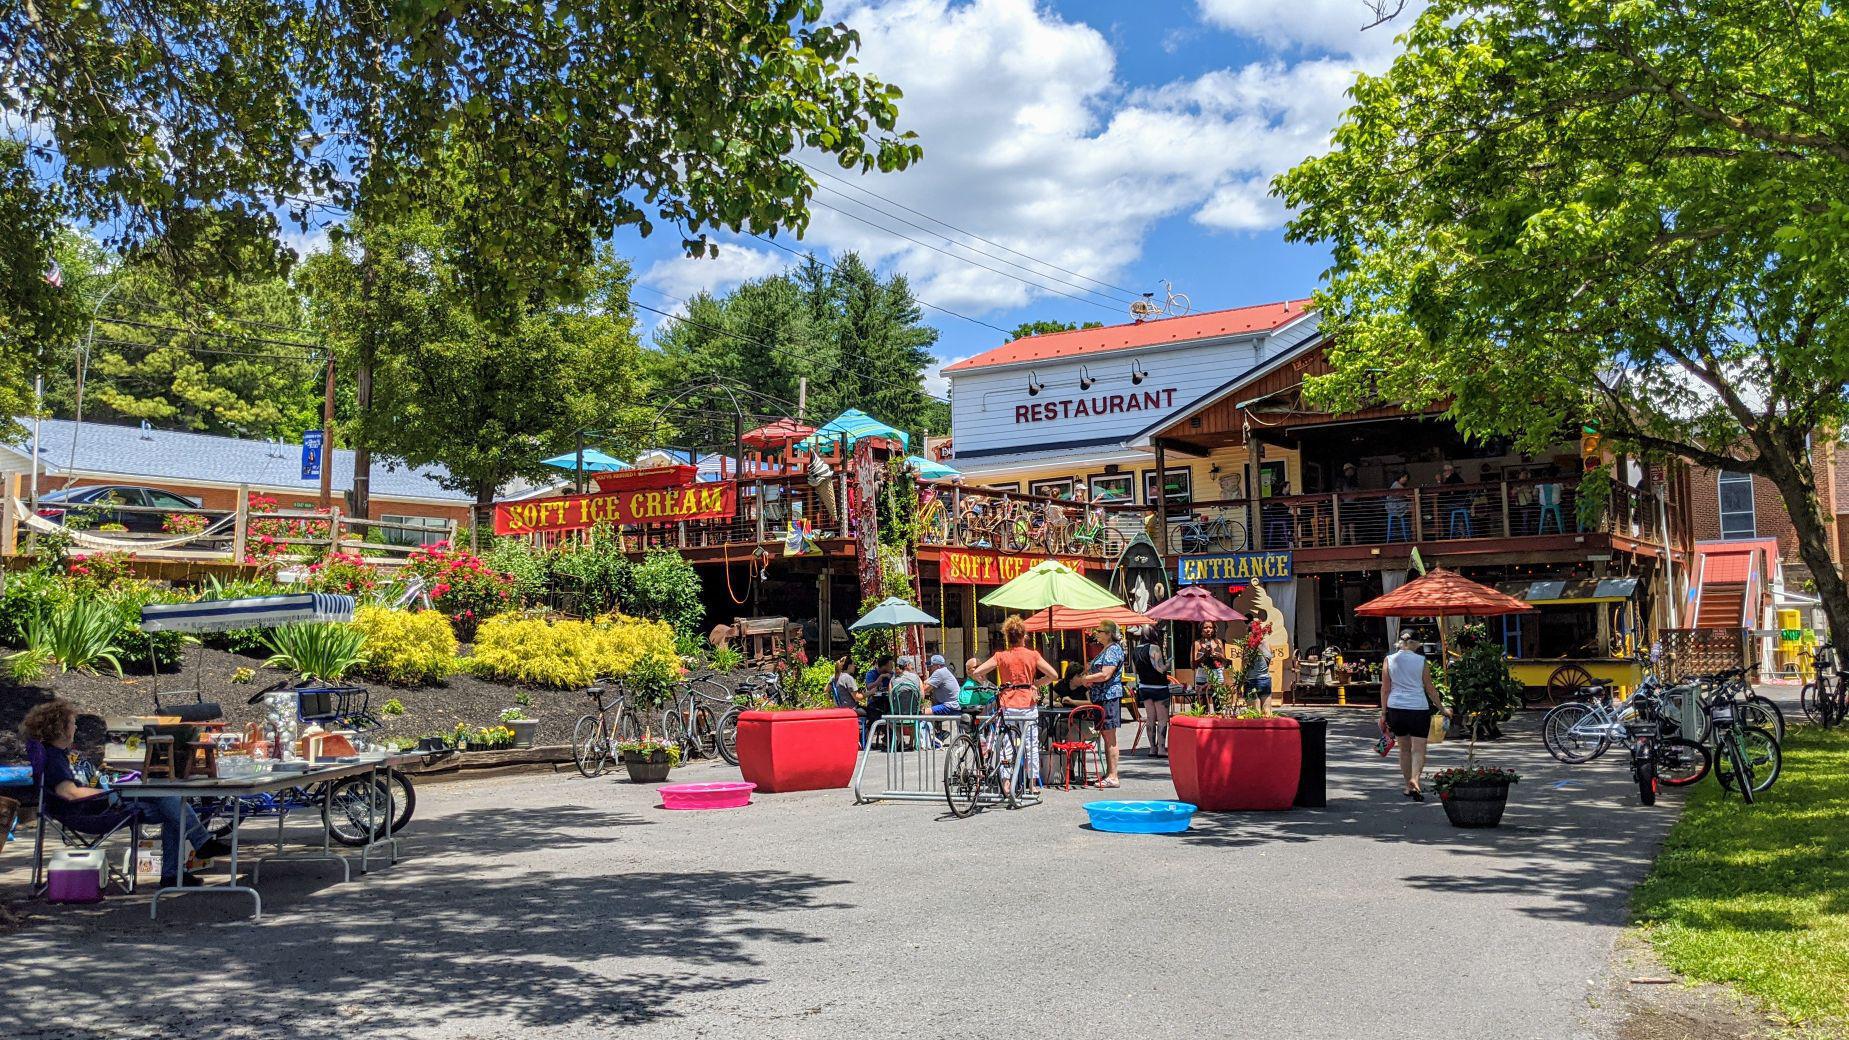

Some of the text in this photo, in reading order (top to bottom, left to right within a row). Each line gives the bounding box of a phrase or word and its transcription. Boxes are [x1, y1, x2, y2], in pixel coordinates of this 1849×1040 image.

[1015, 388, 1178, 424] RESTAURANT
[509, 487, 723, 529] SOFT ICE CREAM
[950, 553, 993, 579] SOFT
[998, 556, 1023, 580] ICE
[1184, 555, 1289, 580] ENTRANCE
[1228, 585, 1247, 593] OPE
